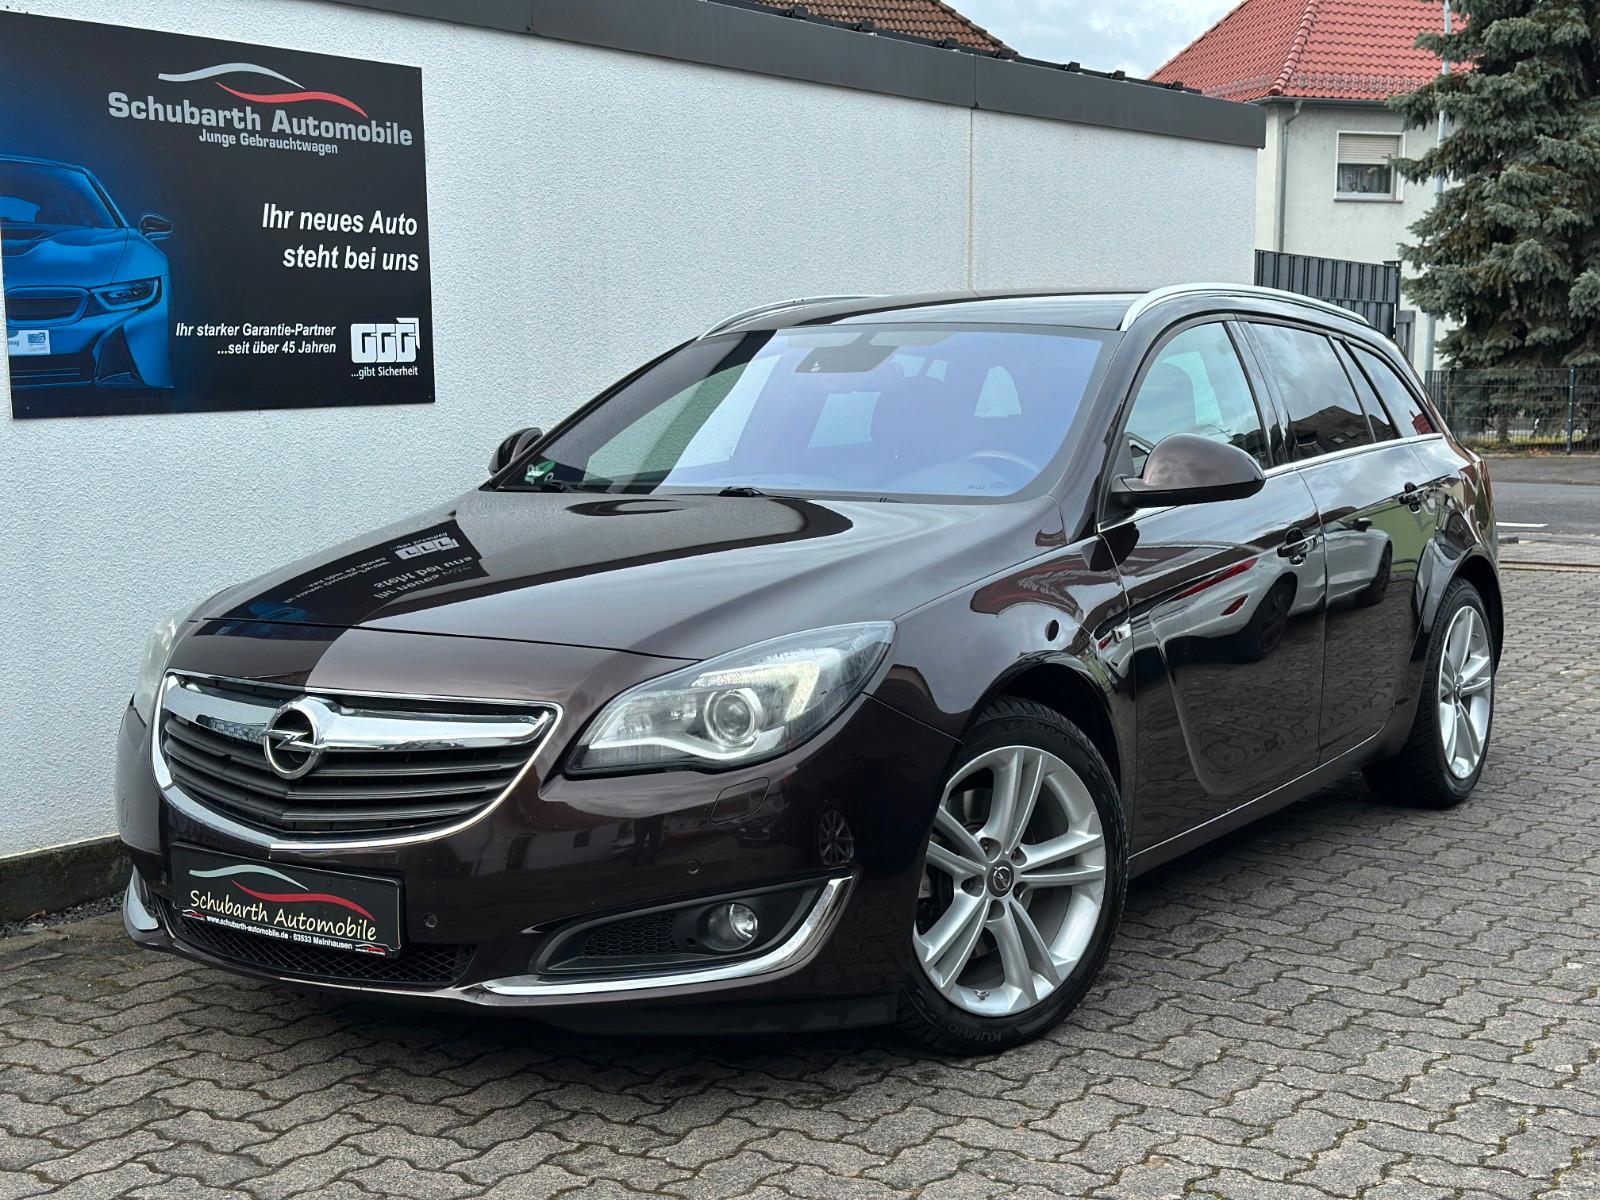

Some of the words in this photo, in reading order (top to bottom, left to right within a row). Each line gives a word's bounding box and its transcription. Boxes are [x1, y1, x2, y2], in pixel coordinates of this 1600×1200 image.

[108, 91, 261, 131] Schubarth
[271, 109, 413, 146] Automobile
[199, 129, 236, 147] Junge
[240, 133, 338, 156] Gebrauchtwagen
[262, 203, 294, 229] Ihr
[300, 211, 364, 233] neues
[369, 210, 418, 236] Auto
[282, 244, 339, 269] steht
[344, 245, 376, 270] bei
[382, 252, 419, 272] uns
[175, 322, 194, 337] Ihr
[196, 322, 240, 337] starker
[242, 323, 337, 337] Garantie-Partner
[217, 341, 251, 355] ...seit
[253, 341, 279, 354] über
[282, 341, 296, 354] 45
[297, 341, 337, 354] Jahren
[351, 366, 376, 380] ...gibt
[378, 366, 418, 377] Sicherheit
[190, 889, 268, 923] Schubarth
[273, 908, 377, 941] Automobile
[206, 915, 289, 940] www.schubarth-automobile.de
[293, 933, 312, 944] 63533
[313, 935, 353, 950] Mainhausen
[948, 1023, 1002, 1042] KUMHO
